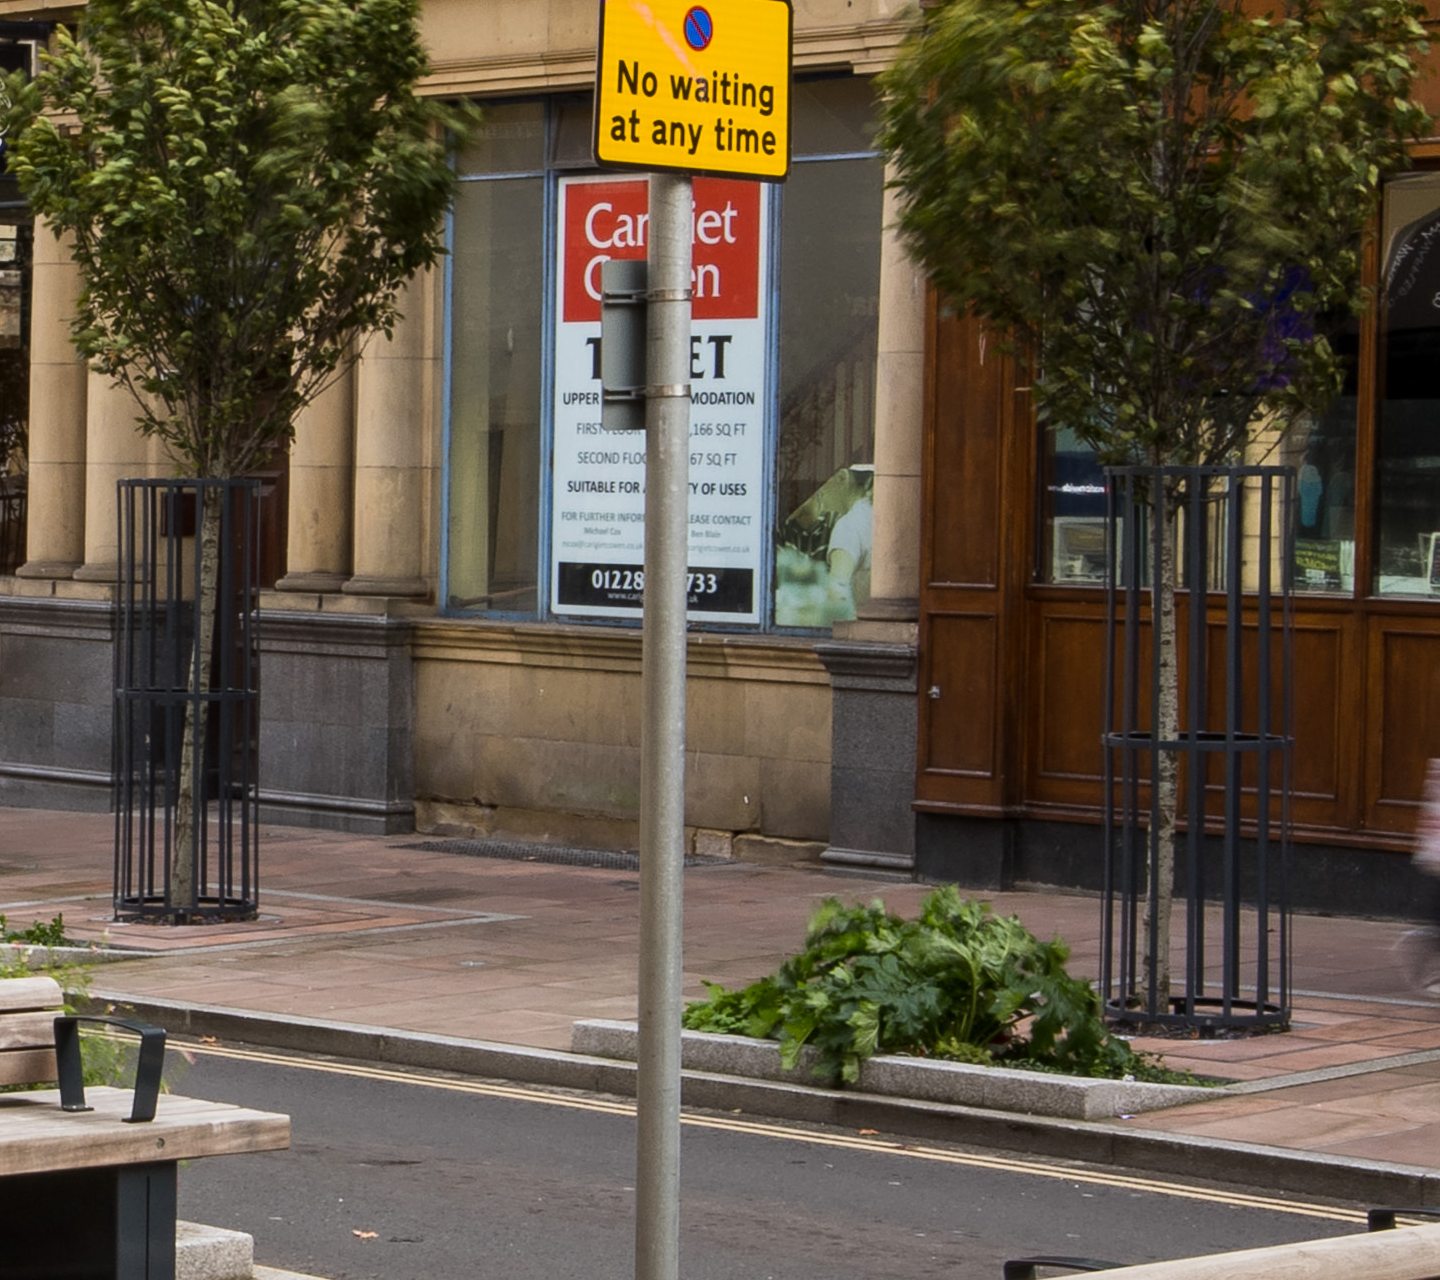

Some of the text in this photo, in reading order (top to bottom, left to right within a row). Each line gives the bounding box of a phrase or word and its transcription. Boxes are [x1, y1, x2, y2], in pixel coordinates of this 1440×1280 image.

[616, 59, 775, 117] No waiting
[610, 108, 777, 156] at any time
[584, 200, 739, 249] Cariet
[689, 334, 733, 380] ET
[562, 391, 755, 406] UPPER MODATION
[576, 422, 603, 435] FIRST
[689, 423, 713, 437] ,166
[715, 423, 732, 437] SQ
[733, 423, 747, 436] FT
[577, 451, 620, 465] SECOND
[689, 453, 703, 466] 67
[705, 453, 722, 467] SQ
[724, 453, 738, 466] FT
[567, 481, 617, 494] SUITABLE
[618, 481, 641, 494] FOR
[701, 483, 717, 495] OF
[718, 483, 748, 496] USES
[561, 511, 577, 521] FOR
[579, 512, 615, 522] FURTHER
[688, 515, 710, 525] EASE
[711, 515, 752, 526] CONTACT
[591, 569, 718, 594] 01228 733
